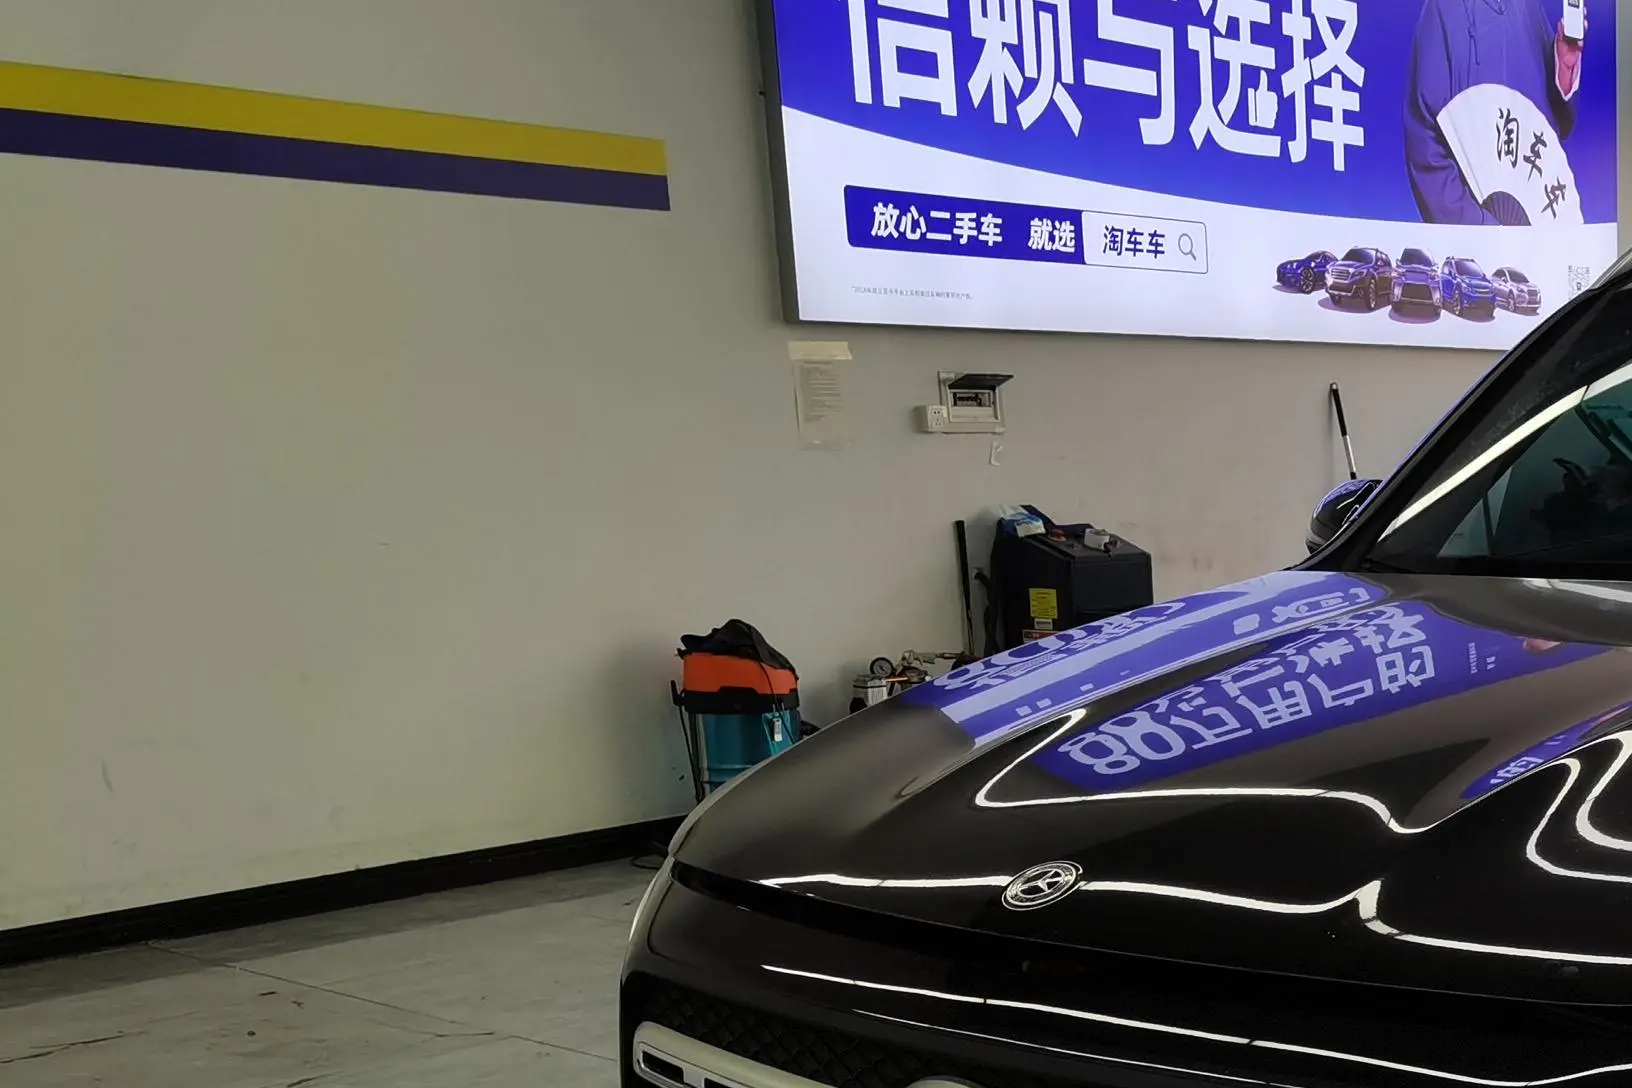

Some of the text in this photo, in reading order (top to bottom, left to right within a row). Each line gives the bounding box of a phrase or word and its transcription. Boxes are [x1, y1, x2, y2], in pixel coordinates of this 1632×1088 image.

[846, 0, 1365, 171] 信赖与选择
[1495, 107, 1567, 219] 淘车车
[871, 202, 1166, 258] 放心二手车 就选 淘车车
